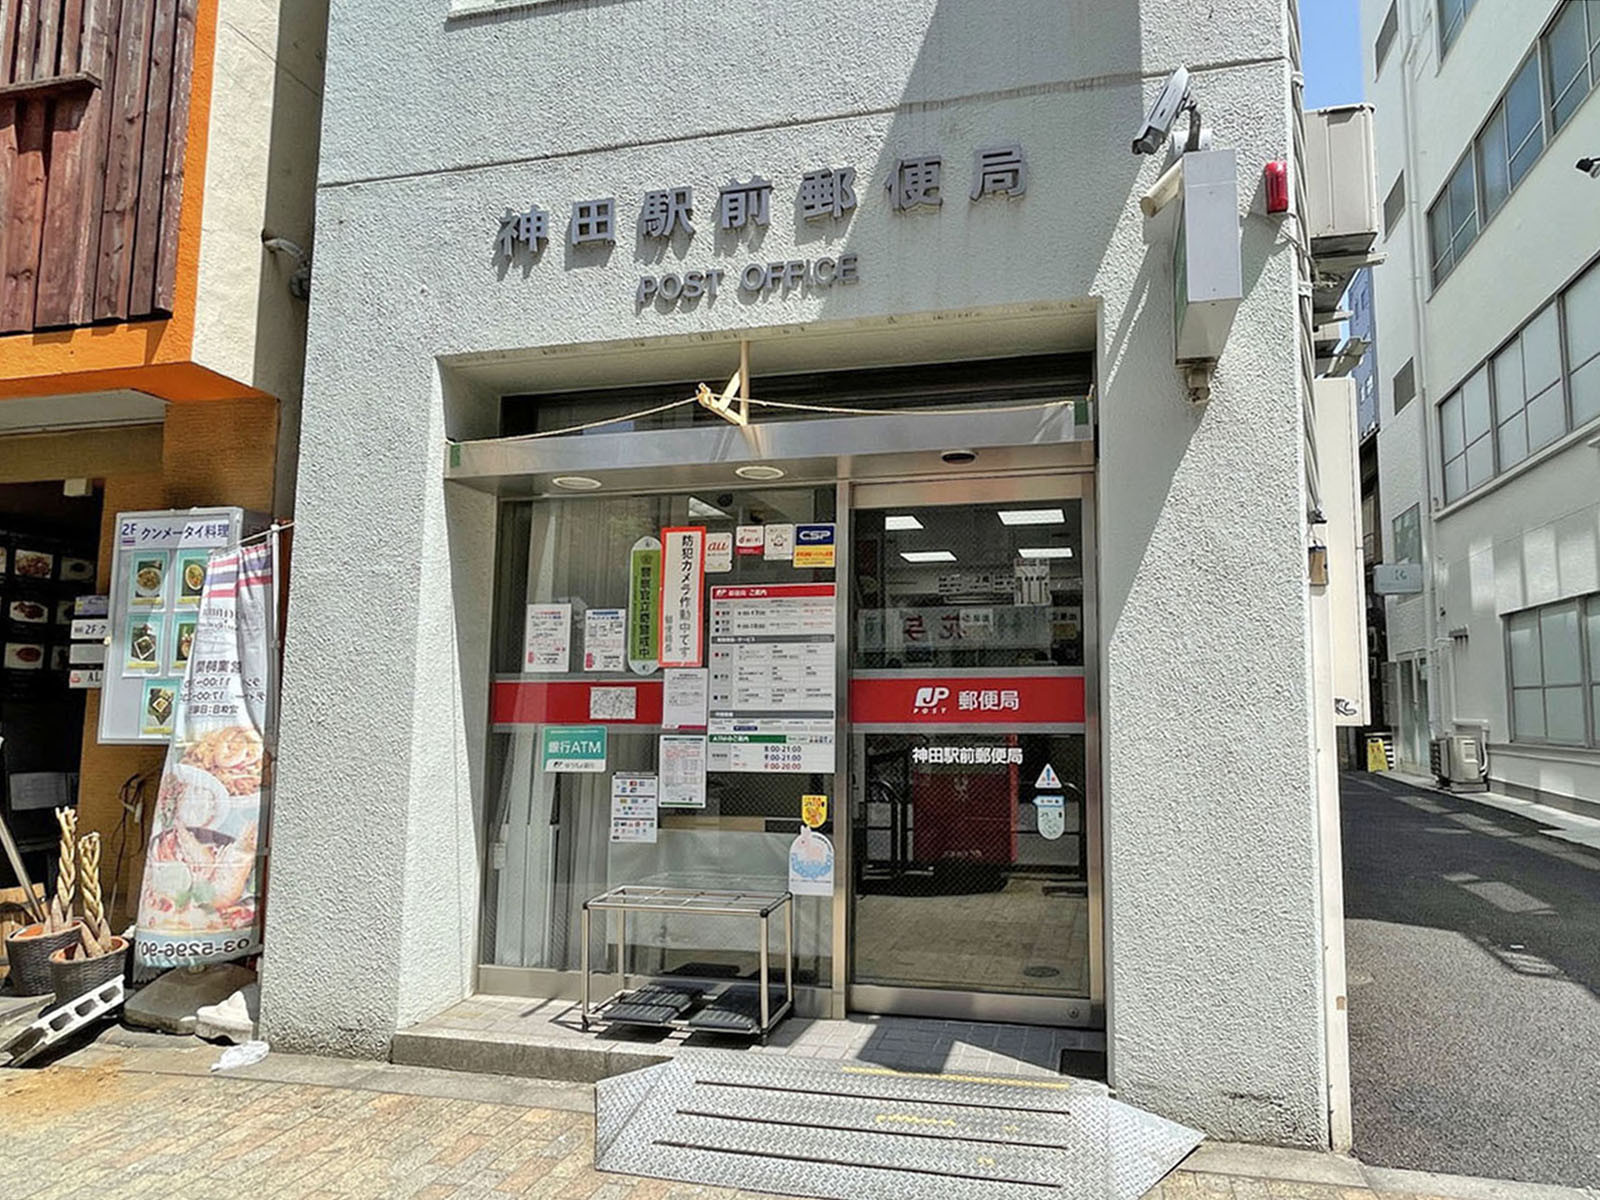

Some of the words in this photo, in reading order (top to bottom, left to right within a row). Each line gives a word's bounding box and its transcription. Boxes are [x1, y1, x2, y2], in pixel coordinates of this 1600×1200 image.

[499, 144, 1028, 258] 神田駅前郵便局
[639, 268, 723, 303] POST
[740, 253, 858, 292] OFFICE
[121, 523, 137, 536] 2F
[141, 523, 230, 540] クンメータイ料理
[799, 529, 831, 540] CSP
[707, 541, 728, 551] au
[914, 687, 950, 707] JP
[958, 690, 1020, 711] 郵便局
[912, 747, 1024, 765] 神田駅前郵便局
